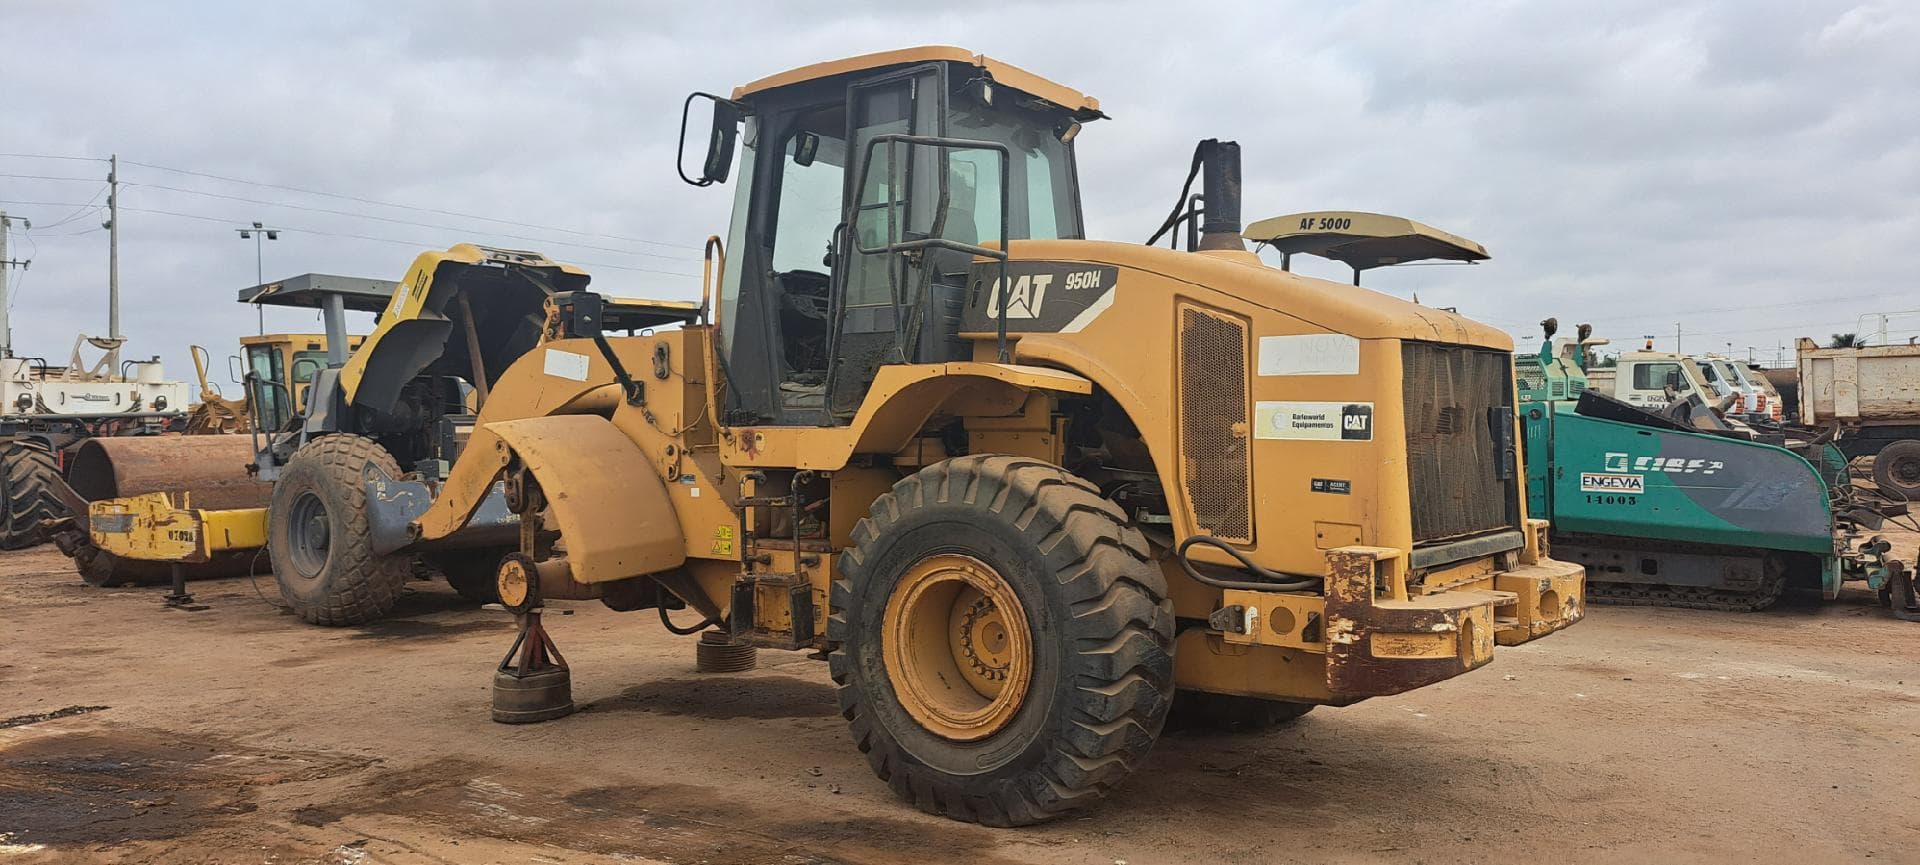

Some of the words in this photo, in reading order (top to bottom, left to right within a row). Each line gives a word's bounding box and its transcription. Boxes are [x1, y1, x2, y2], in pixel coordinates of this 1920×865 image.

[1299, 217, 1315, 230] AF
[1319, 217, 1351, 230] 5000
[1065, 270, 1101, 290] 950H
[1344, 414, 1368, 431] CAT
[1582, 476, 1642, 489] ENGEVIA
